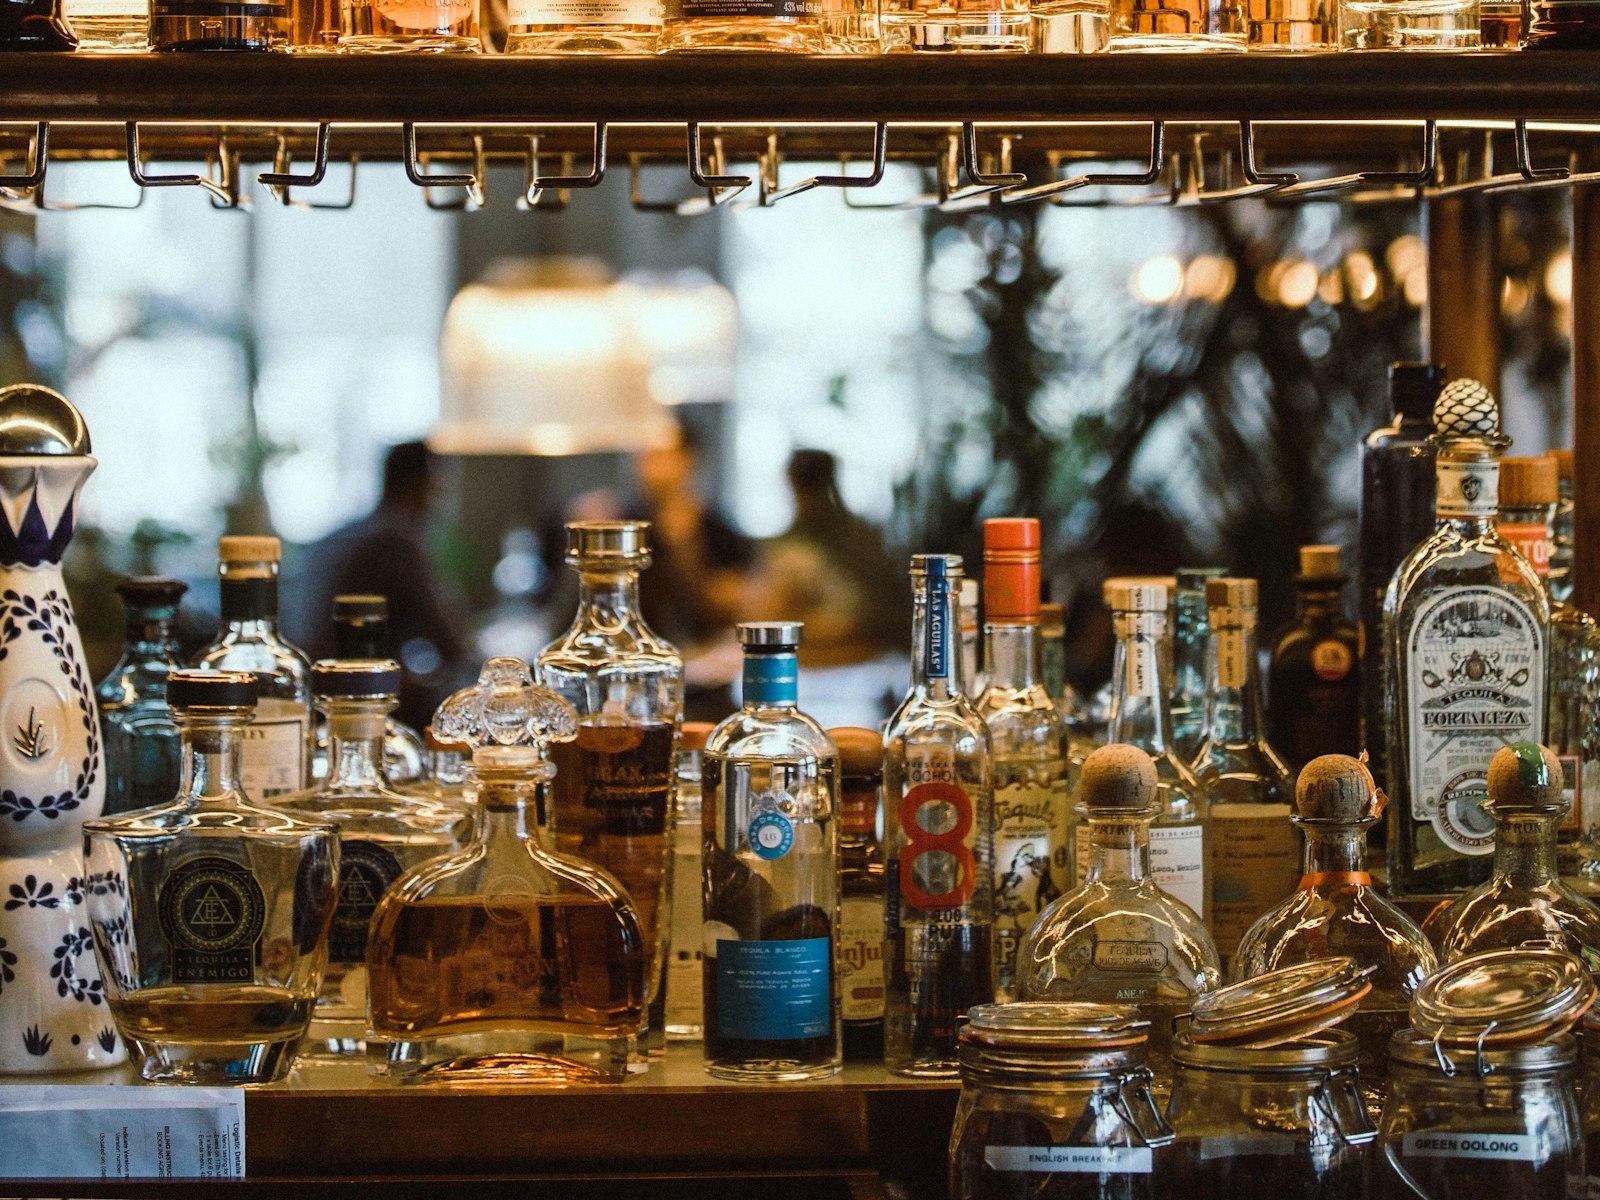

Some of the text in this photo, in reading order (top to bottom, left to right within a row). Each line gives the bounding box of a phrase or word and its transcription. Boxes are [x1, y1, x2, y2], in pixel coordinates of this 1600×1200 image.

[784, 1, 796, 11] 43%
[1445, 689, 1504, 703] TEQUILA
[1423, 711, 1527, 725] FORTALEZA
[901, 782, 976, 911] 8
[178, 967, 248, 977] ENEMIGO
[163, 1126, 171, 1150] BILLING
[233, 1122, 242, 1174] Logistic Details
[1415, 1139, 1518, 1152] GREEN OOLONG
[1028, 1154, 1069, 1162] ENGLISH
